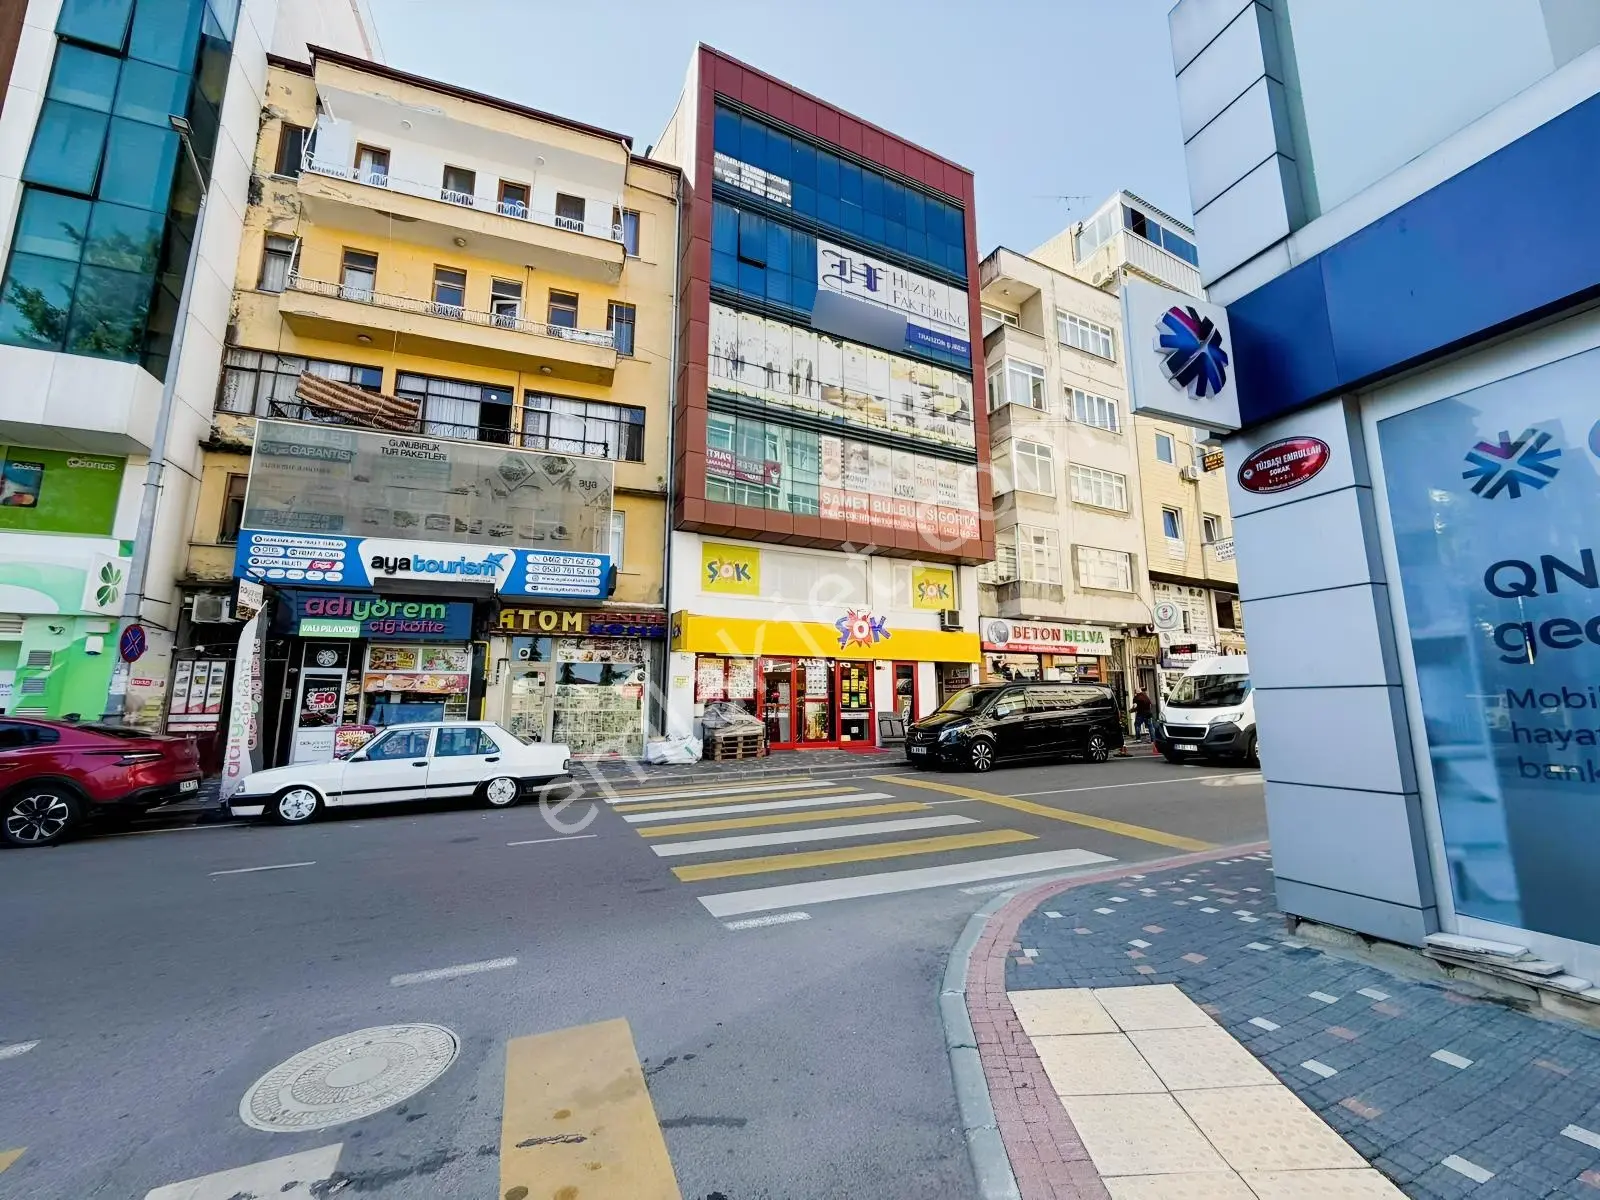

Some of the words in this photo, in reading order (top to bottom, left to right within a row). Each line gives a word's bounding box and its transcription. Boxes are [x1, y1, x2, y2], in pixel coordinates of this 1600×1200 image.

[499, 608, 584, 633] ATOM
[1012, 625, 1061, 642] BETON
[1063, 628, 1105, 645] HELVA
[1506, 685, 1600, 710] Mobi
